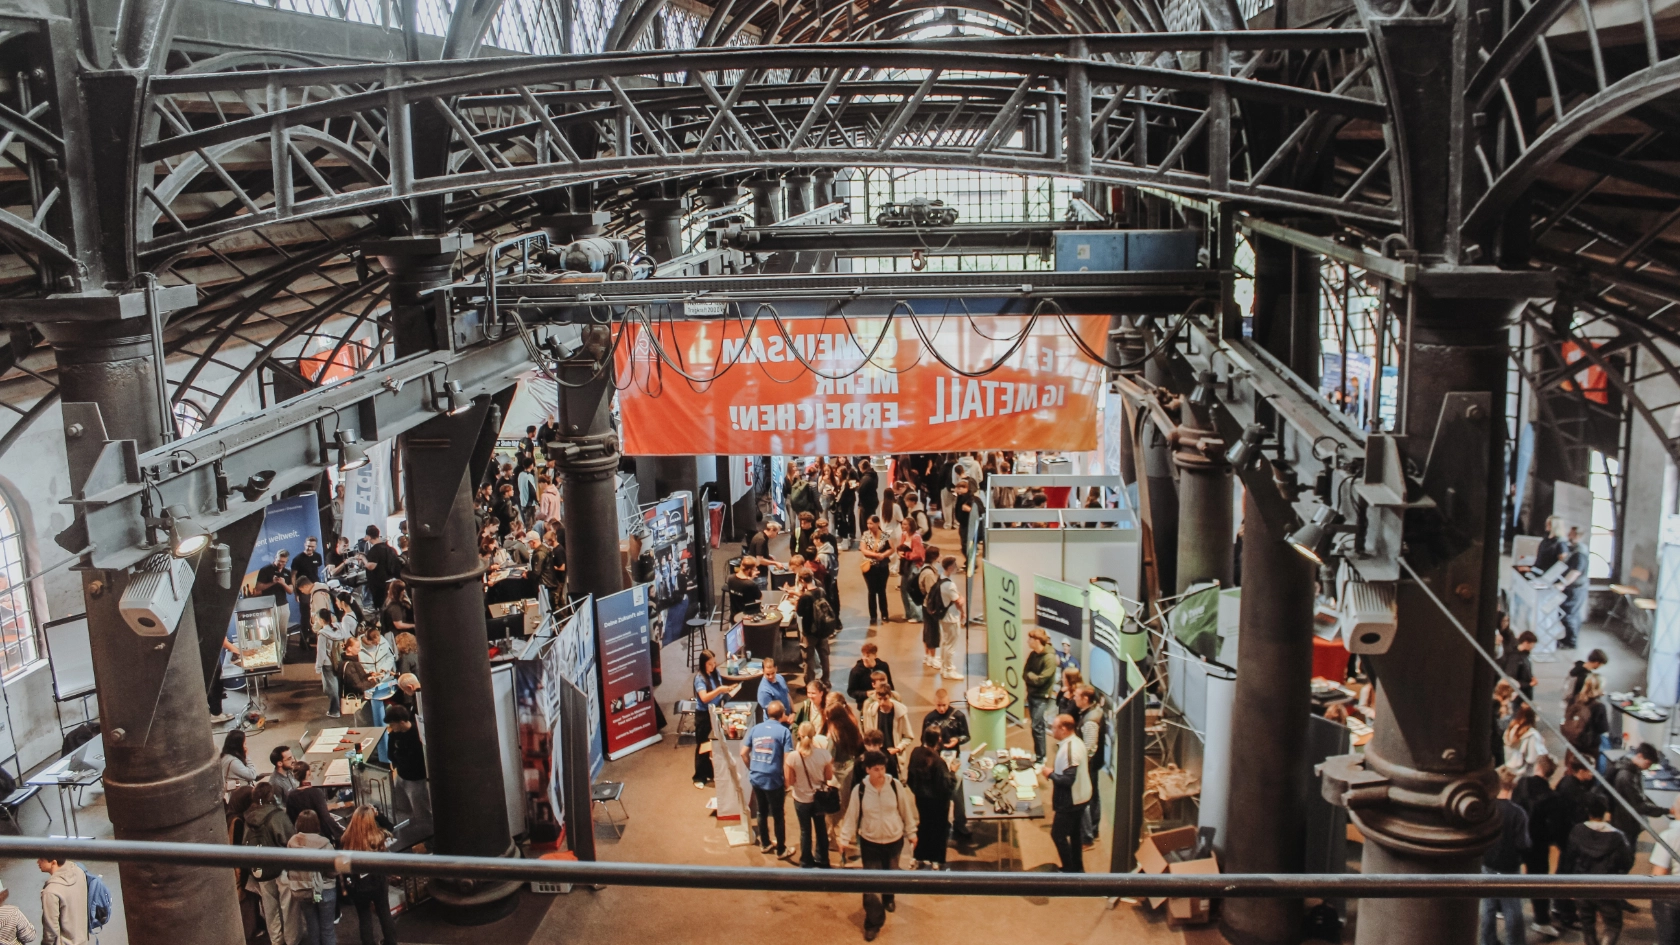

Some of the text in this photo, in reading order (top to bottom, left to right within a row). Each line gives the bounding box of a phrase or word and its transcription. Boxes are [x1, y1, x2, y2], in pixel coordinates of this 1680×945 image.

[268, 530, 300, 543] weltweit.
[617, 612, 637, 623] Zukunft
[998, 577, 1020, 720] Novelis
